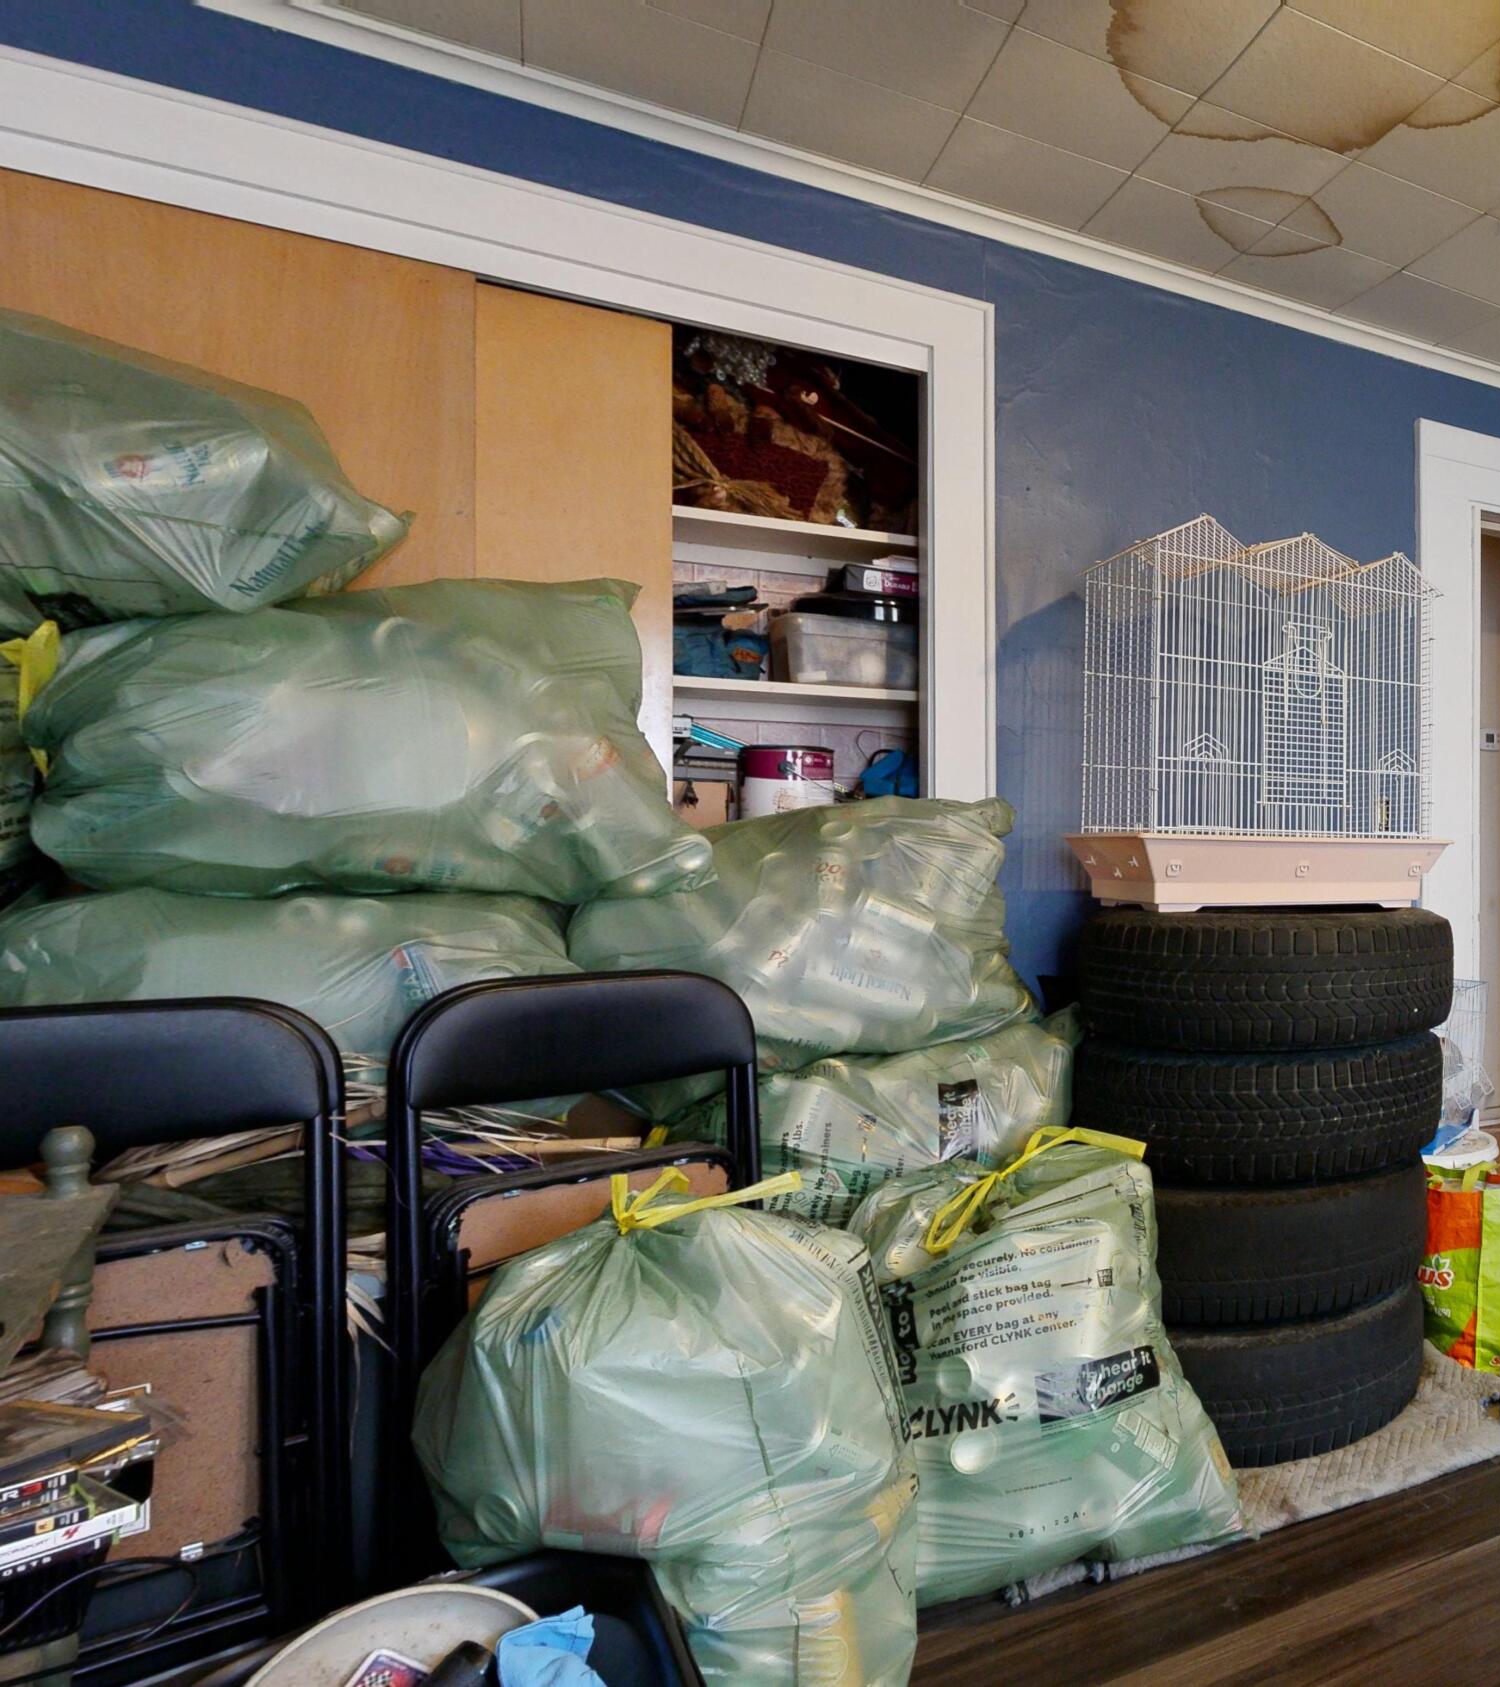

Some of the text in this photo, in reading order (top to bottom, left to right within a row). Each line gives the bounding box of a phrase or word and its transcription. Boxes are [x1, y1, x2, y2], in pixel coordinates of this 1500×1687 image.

[962, 1251, 1018, 1271] securely.
[960, 1273, 975, 1284] be
[973, 1286, 1003, 1301] stick
[1005, 1280, 1029, 1295] bag
[1031, 1278, 1052, 1290] tag
[956, 1302, 993, 1320] space
[996, 1289, 1054, 1312] provided.
[953, 1324, 993, 1343] EVERY
[995, 1317, 1019, 1332] bag
[1022, 1314, 1035, 1326] at
[1037, 1309, 1060, 1322] any
[990, 1327, 1033, 1346] CLYNK
[1035, 1319, 1078, 1336] center.
[1101, 1357, 1138, 1380] hear
[1140, 1350, 1152, 1366] it
[909, 1398, 1004, 1440] CLYNK
